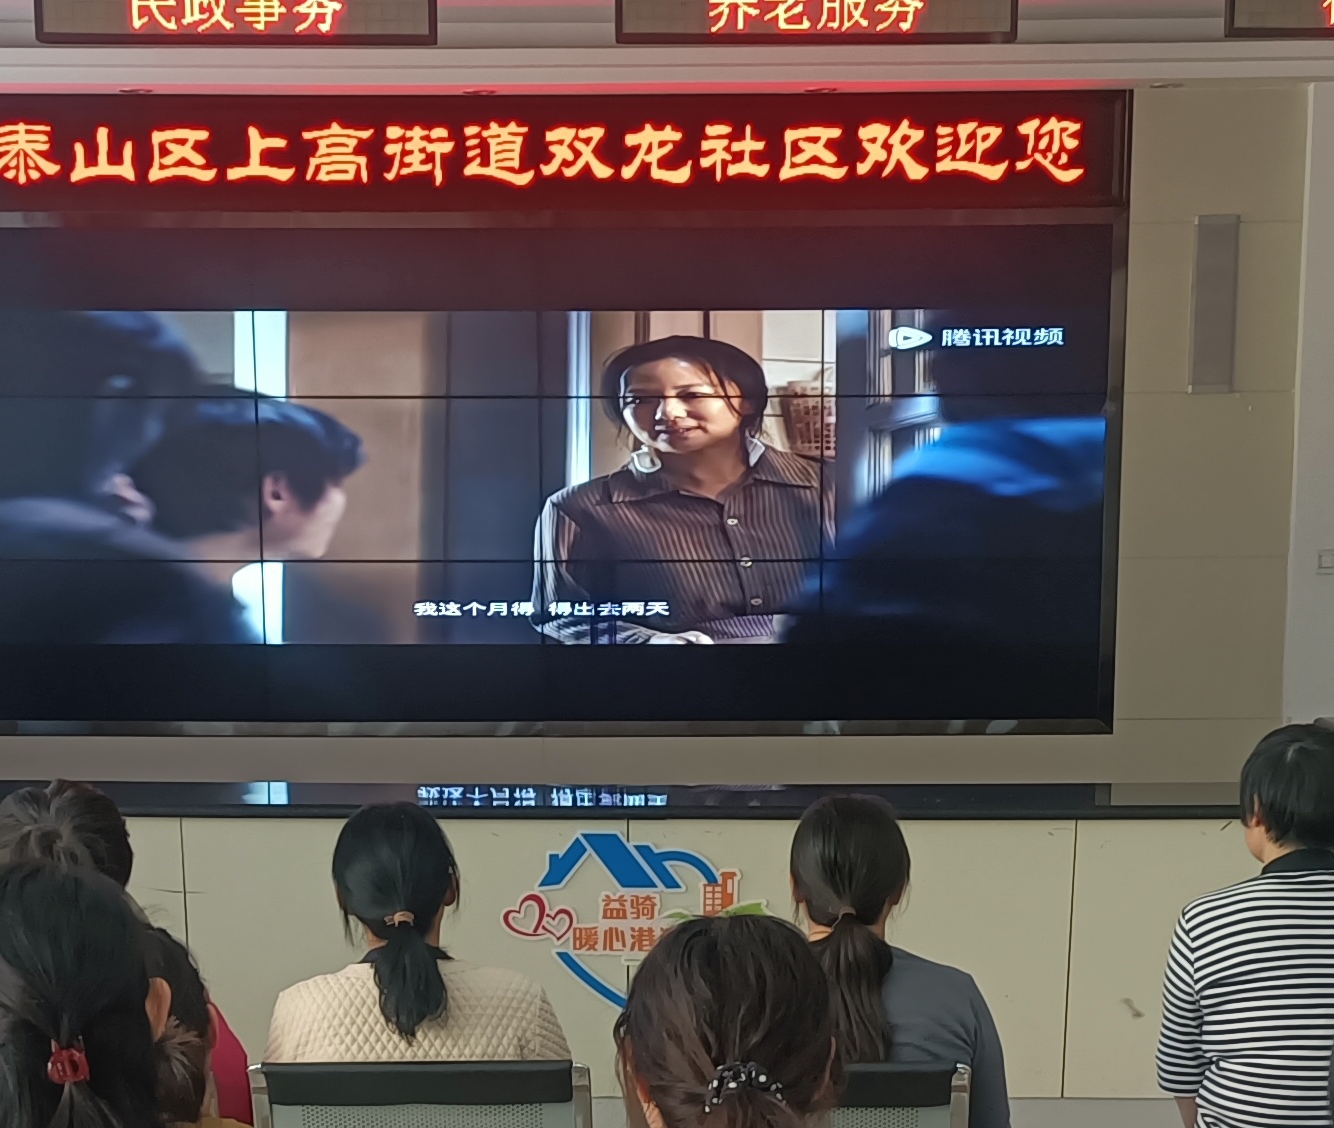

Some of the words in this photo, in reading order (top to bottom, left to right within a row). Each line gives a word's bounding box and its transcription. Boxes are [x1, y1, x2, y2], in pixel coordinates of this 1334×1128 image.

[130, 0, 343, 33] 民政事务
[708, 0, 924, 32] 养老服务
[942, 327, 1065, 347] 腾讯视频
[413, 601, 535, 617] 我这个月得
[548, 601, 670, 617] 得出去两天
[601, 894, 658, 920] 益骑
[572, 926, 669, 952] 暖心港
